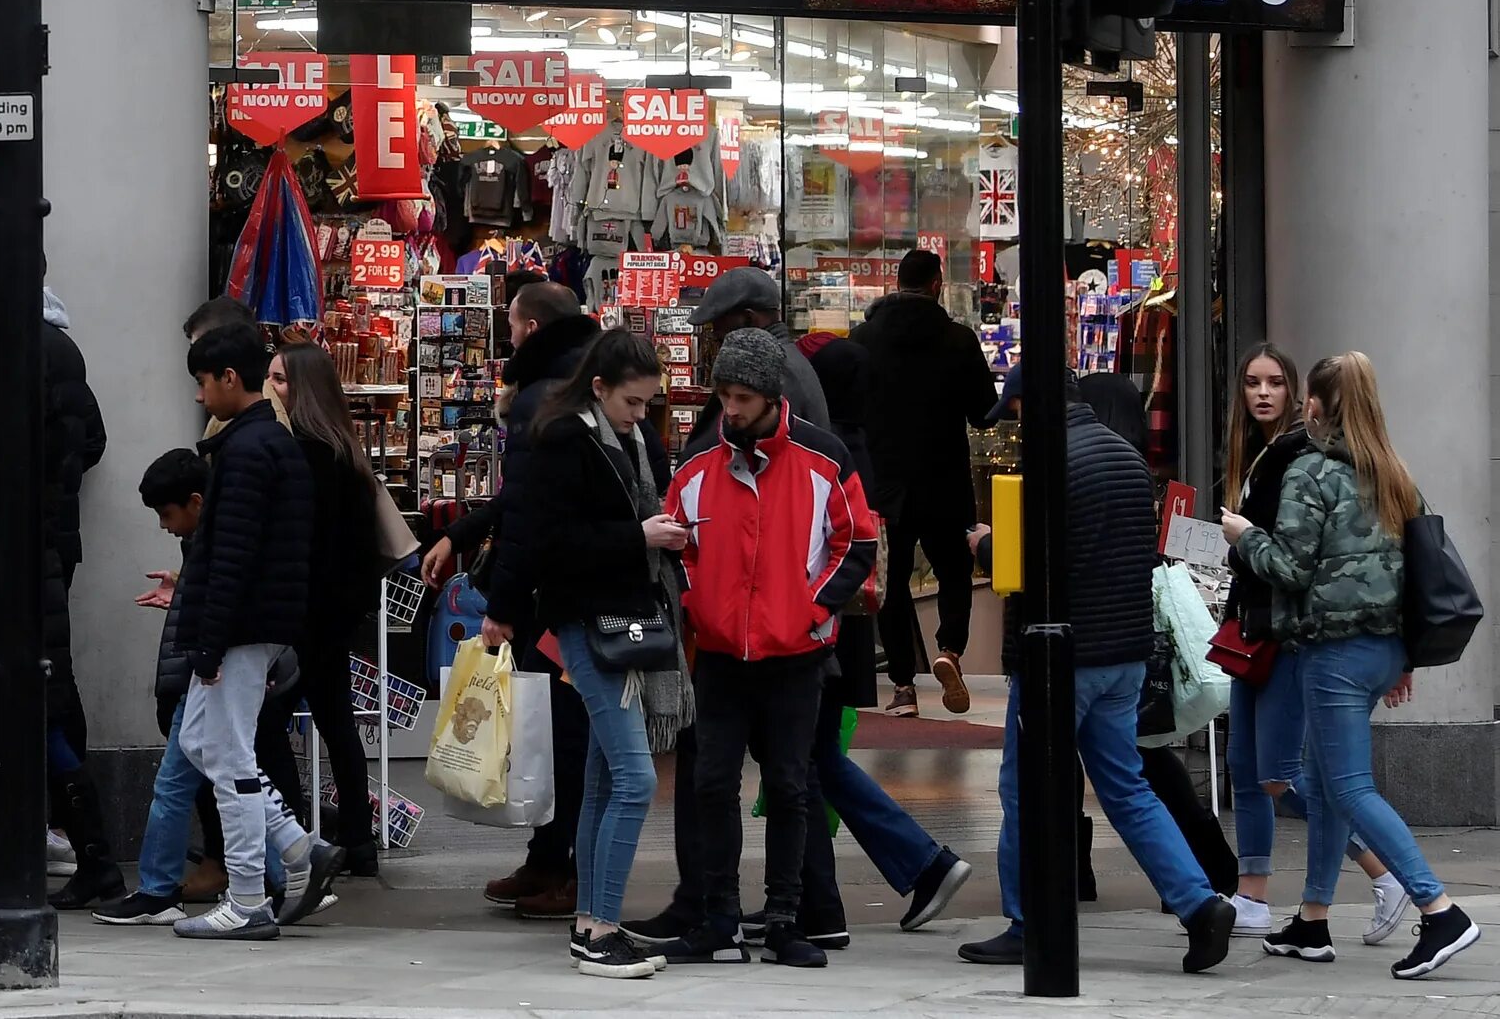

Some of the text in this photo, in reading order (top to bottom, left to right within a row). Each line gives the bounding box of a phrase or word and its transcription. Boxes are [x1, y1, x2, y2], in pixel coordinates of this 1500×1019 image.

[421, 55, 439, 64] Fire
[474, 60, 565, 88] SALE
[242, 94, 323, 107] NOW ON
[472, 92, 565, 106] NOW ON
[627, 95, 705, 121] SALE
[581, 112, 604, 125] ON
[626, 124, 704, 136] NOW ON
[356, 243, 400, 262] £2.99
[354, 265, 367, 281] 2
[368, 266, 382, 276] FOR
[1150, 679, 1169, 691] M&S
